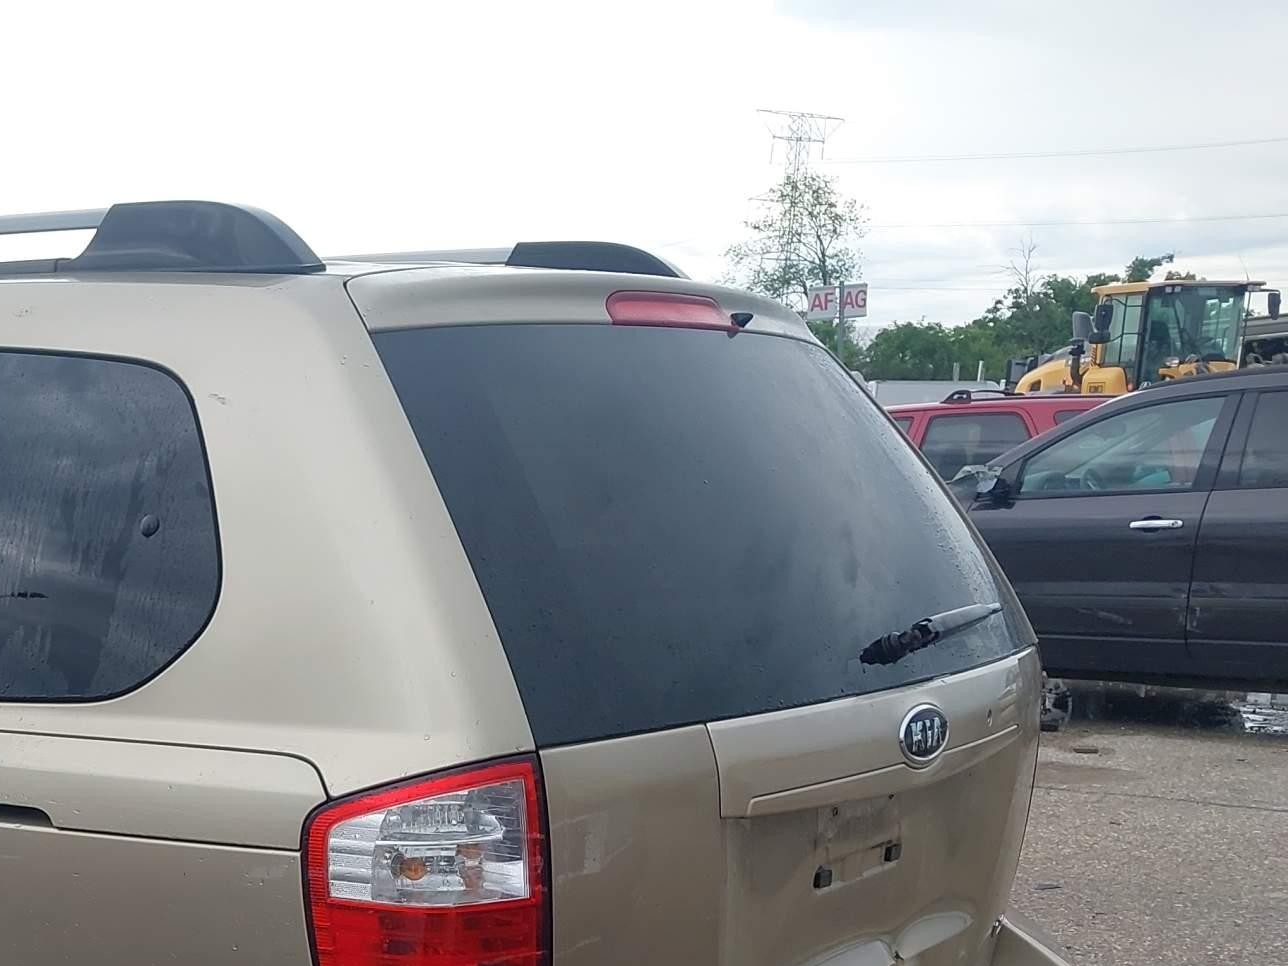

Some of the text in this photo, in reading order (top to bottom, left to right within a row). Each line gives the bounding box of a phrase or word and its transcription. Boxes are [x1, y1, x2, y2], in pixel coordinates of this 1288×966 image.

[810, 291, 834, 313] AF
[843, 289, 867, 310] AG
[909, 716, 943, 753] KIA
